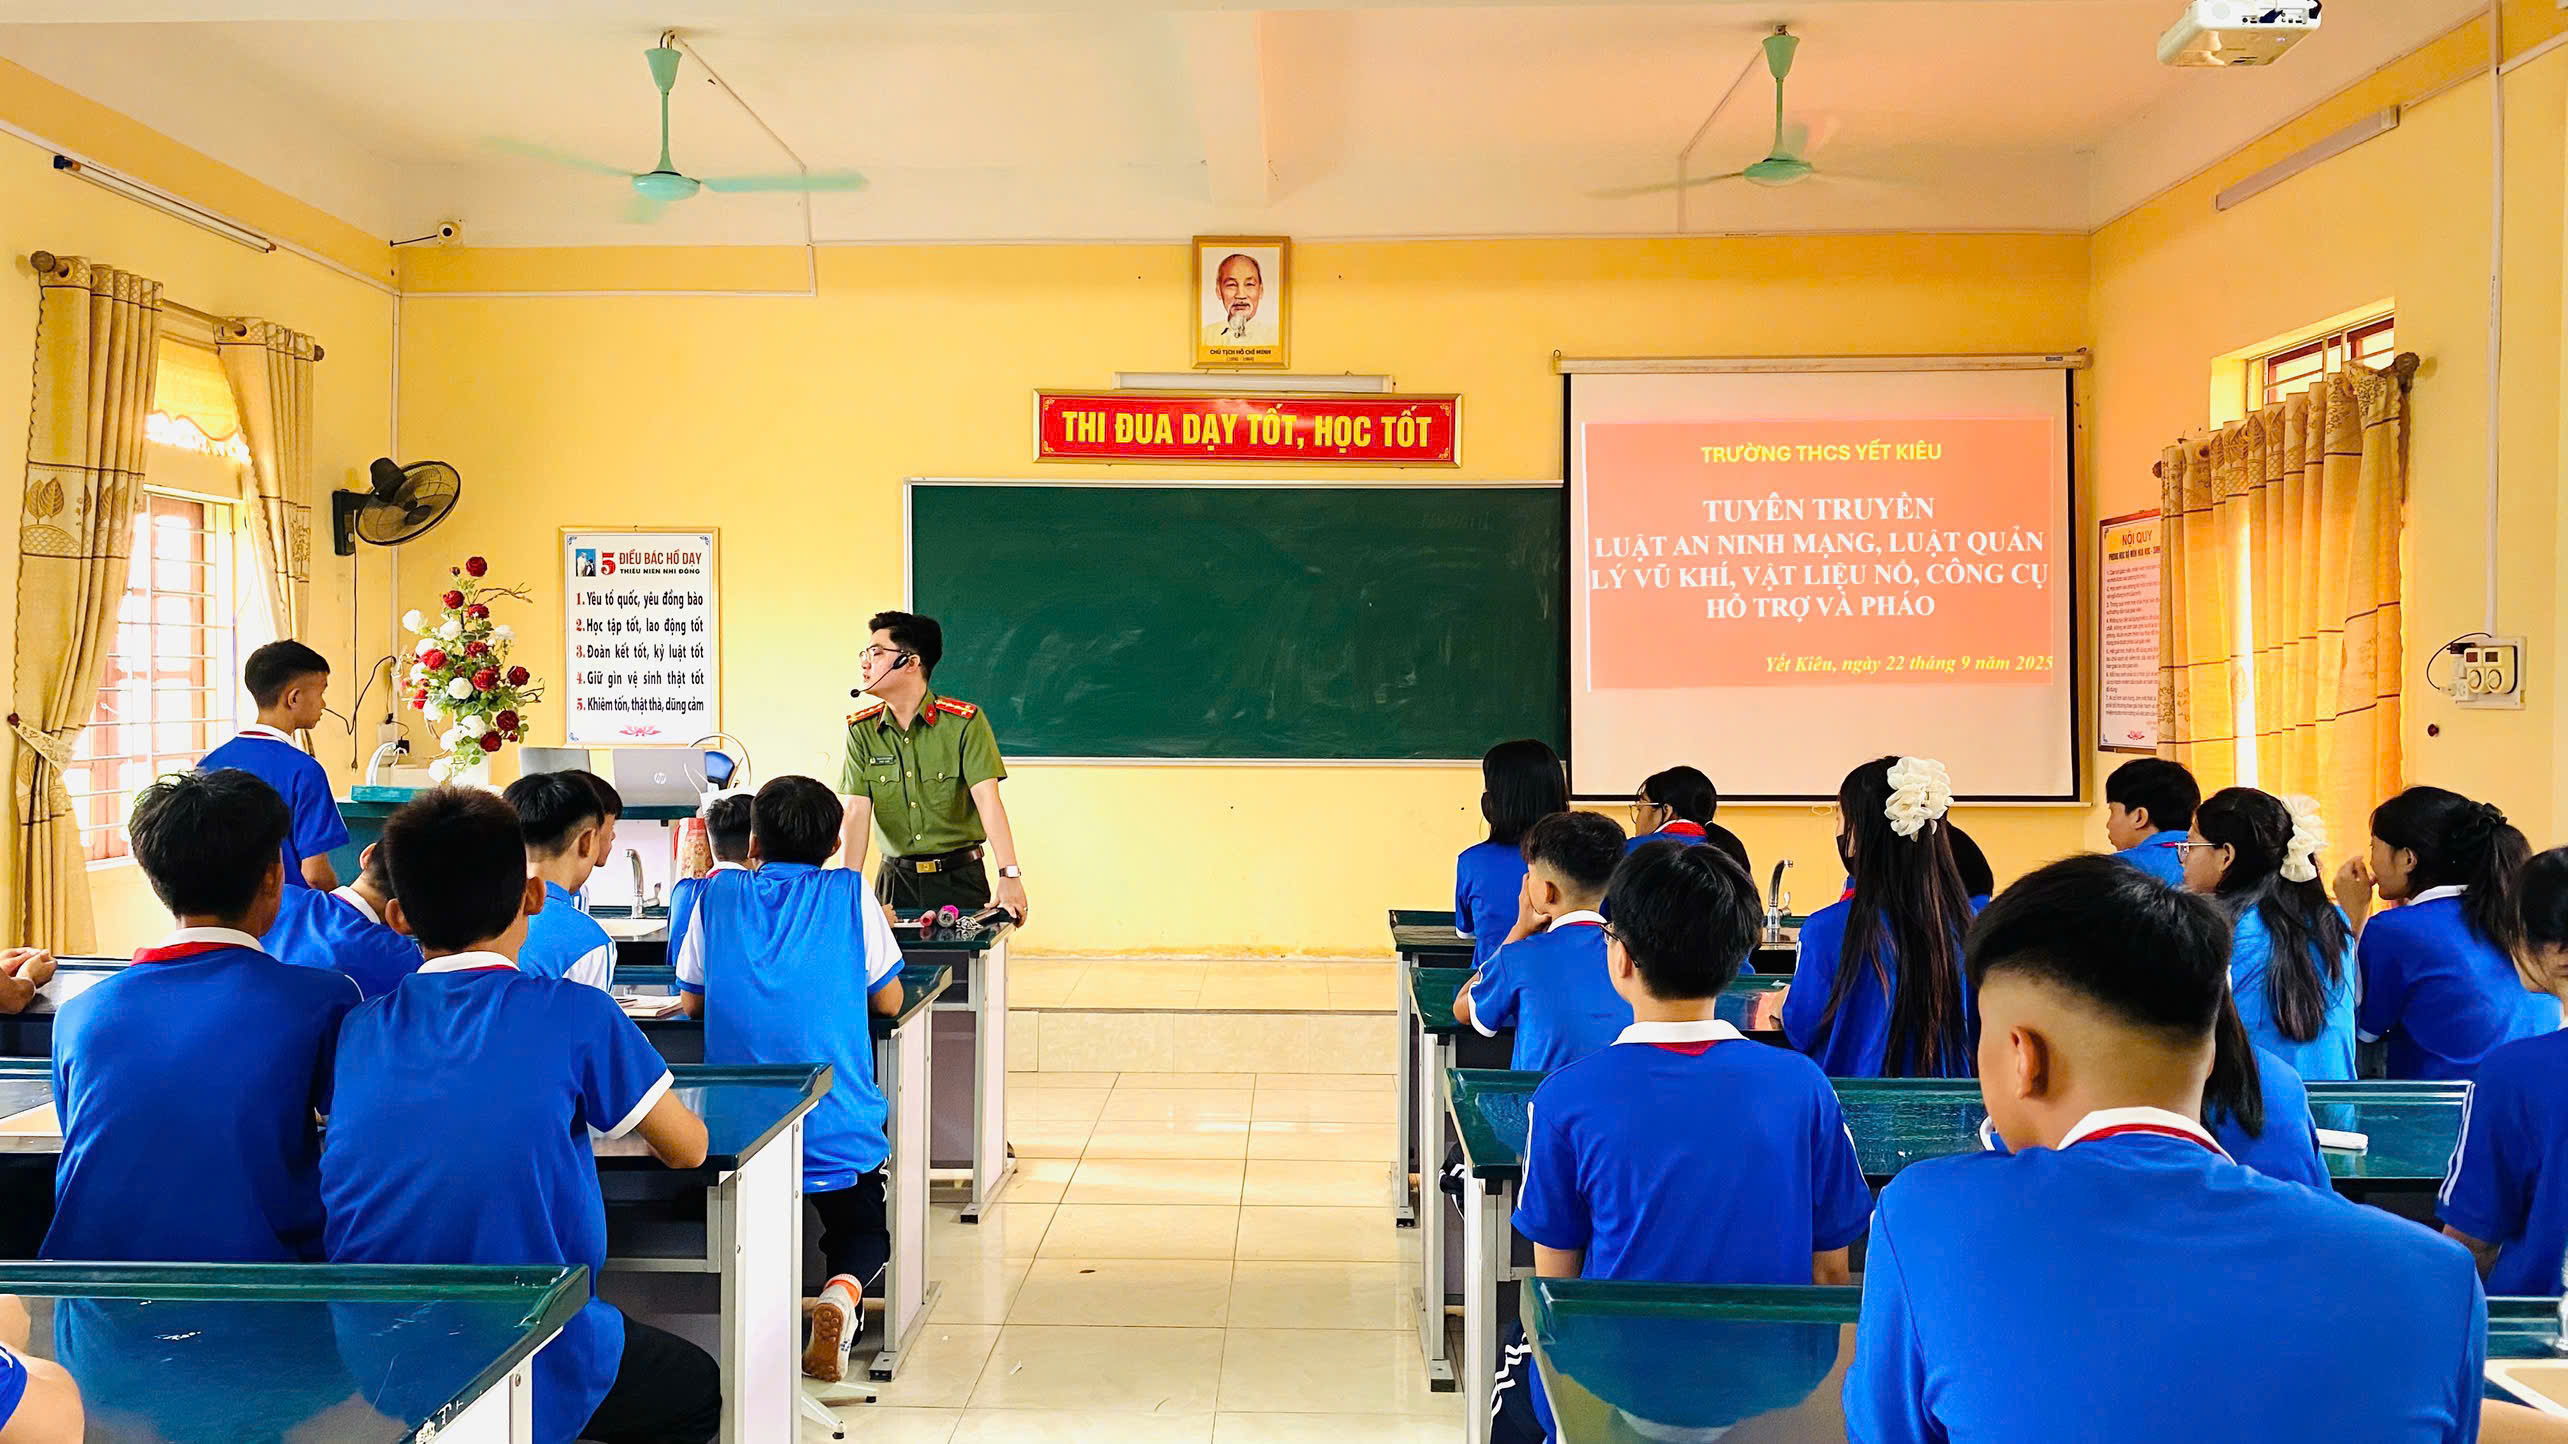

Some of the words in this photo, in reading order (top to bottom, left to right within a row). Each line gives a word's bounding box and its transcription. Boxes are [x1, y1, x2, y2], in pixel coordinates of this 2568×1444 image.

[1062, 410, 1106, 443] THI
[1115, 411, 1173, 444] ĐUA
[1183, 413, 1238, 451] DẠY
[1247, 402, 1305, 450] TỐT,
[1314, 415, 1371, 454] HỌC
[1381, 404, 1432, 448] TỐT
[1700, 442, 1792, 463] TRƯỜNG
[1796, 444, 1851, 462] THCS
[1855, 439, 1891, 460] YẾT
[1896, 440, 1942, 460] KIÊU
[1703, 492, 1804, 522] TUYÊN
[1812, 491, 1936, 521] TRUYỀN
[1595, 534, 1667, 562] LUẬT
[1673, 535, 1710, 556] AN
[1717, 533, 1785, 555] NINH
[1794, 531, 1882, 559] MẠNG,
[1889, 529, 1960, 558] LUẬT
[1967, 525, 2044, 555] QUẢN
[2122, 531, 2135, 547] NỘI
[2136, 530, 2152, 543] QUY
[601, 552, 616, 575] 5
[644, 550, 664, 564] BÁC
[682, 552, 702, 567] DẠY
[1591, 563, 1628, 590] LÝ
[1634, 563, 1671, 588] VŨ
[1680, 561, 1736, 589] KHÍ,
[1742, 563, 1797, 591] VẬT
[1804, 562, 1867, 590] LIỆU
[1875, 559, 1920, 587] NỔ,
[1926, 557, 2004, 584] CÔNG
[2011, 563, 2048, 589] CỤ
[576, 592, 585, 606] 1.
[587, 592, 602, 606] Yêu
[618, 589, 640, 609] quốc,
[644, 592, 658, 609] yêu
[662, 589, 684, 609] đồng
[688, 592, 703, 606] bào
[1706, 593, 1746, 619] HỖ
[1753, 595, 1811, 623] TRỢ
[1816, 591, 1854, 617] VÀ
[1861, 590, 1936, 616] PHÁO
[576, 618, 585, 632] 2.
[586, 618, 602, 636] Học
[608, 618, 622, 636] tập
[626, 616, 642, 633] tốt,
[646, 618, 660, 632] lao
[664, 618, 686, 636] động
[691, 616, 704, 632] tốt
[576, 645, 585, 658] 3.
[587, 644, 610, 658] Đoàn
[616, 642, 629, 658] kết
[634, 642, 649, 660] tốt,
[654, 644, 664, 661] kỷ
[669, 644, 686, 661] luật
[691, 642, 704, 658] tốt
[1766, 652, 1791, 672] Yết
[1795, 655, 1837, 673] Kiêu,
[1842, 656, 1881, 675] ngày
[1886, 656, 1905, 671] 22
[1909, 655, 1956, 673] tháng
[1960, 656, 1972, 671] 9
[1976, 656, 2010, 671] năm
[2015, 655, 2054, 671] 2025
[576, 672, 585, 684] 4.
[587, 671, 603, 684] Giữ
[608, 671, 622, 688] gìn
[628, 671, 638, 688] vệ
[644, 671, 661, 684] sinh
[668, 671, 685, 688] thật
[691, 669, 704, 684] tốt
[576, 698, 586, 711] 5.
[588, 697, 612, 711] Khiêm
[614, 695, 630, 712] tốn,
[632, 697, 647, 715] thật
[649, 697, 664, 712] thà,
[666, 697, 686, 714] dũng
[688, 697, 704, 711] cảm
